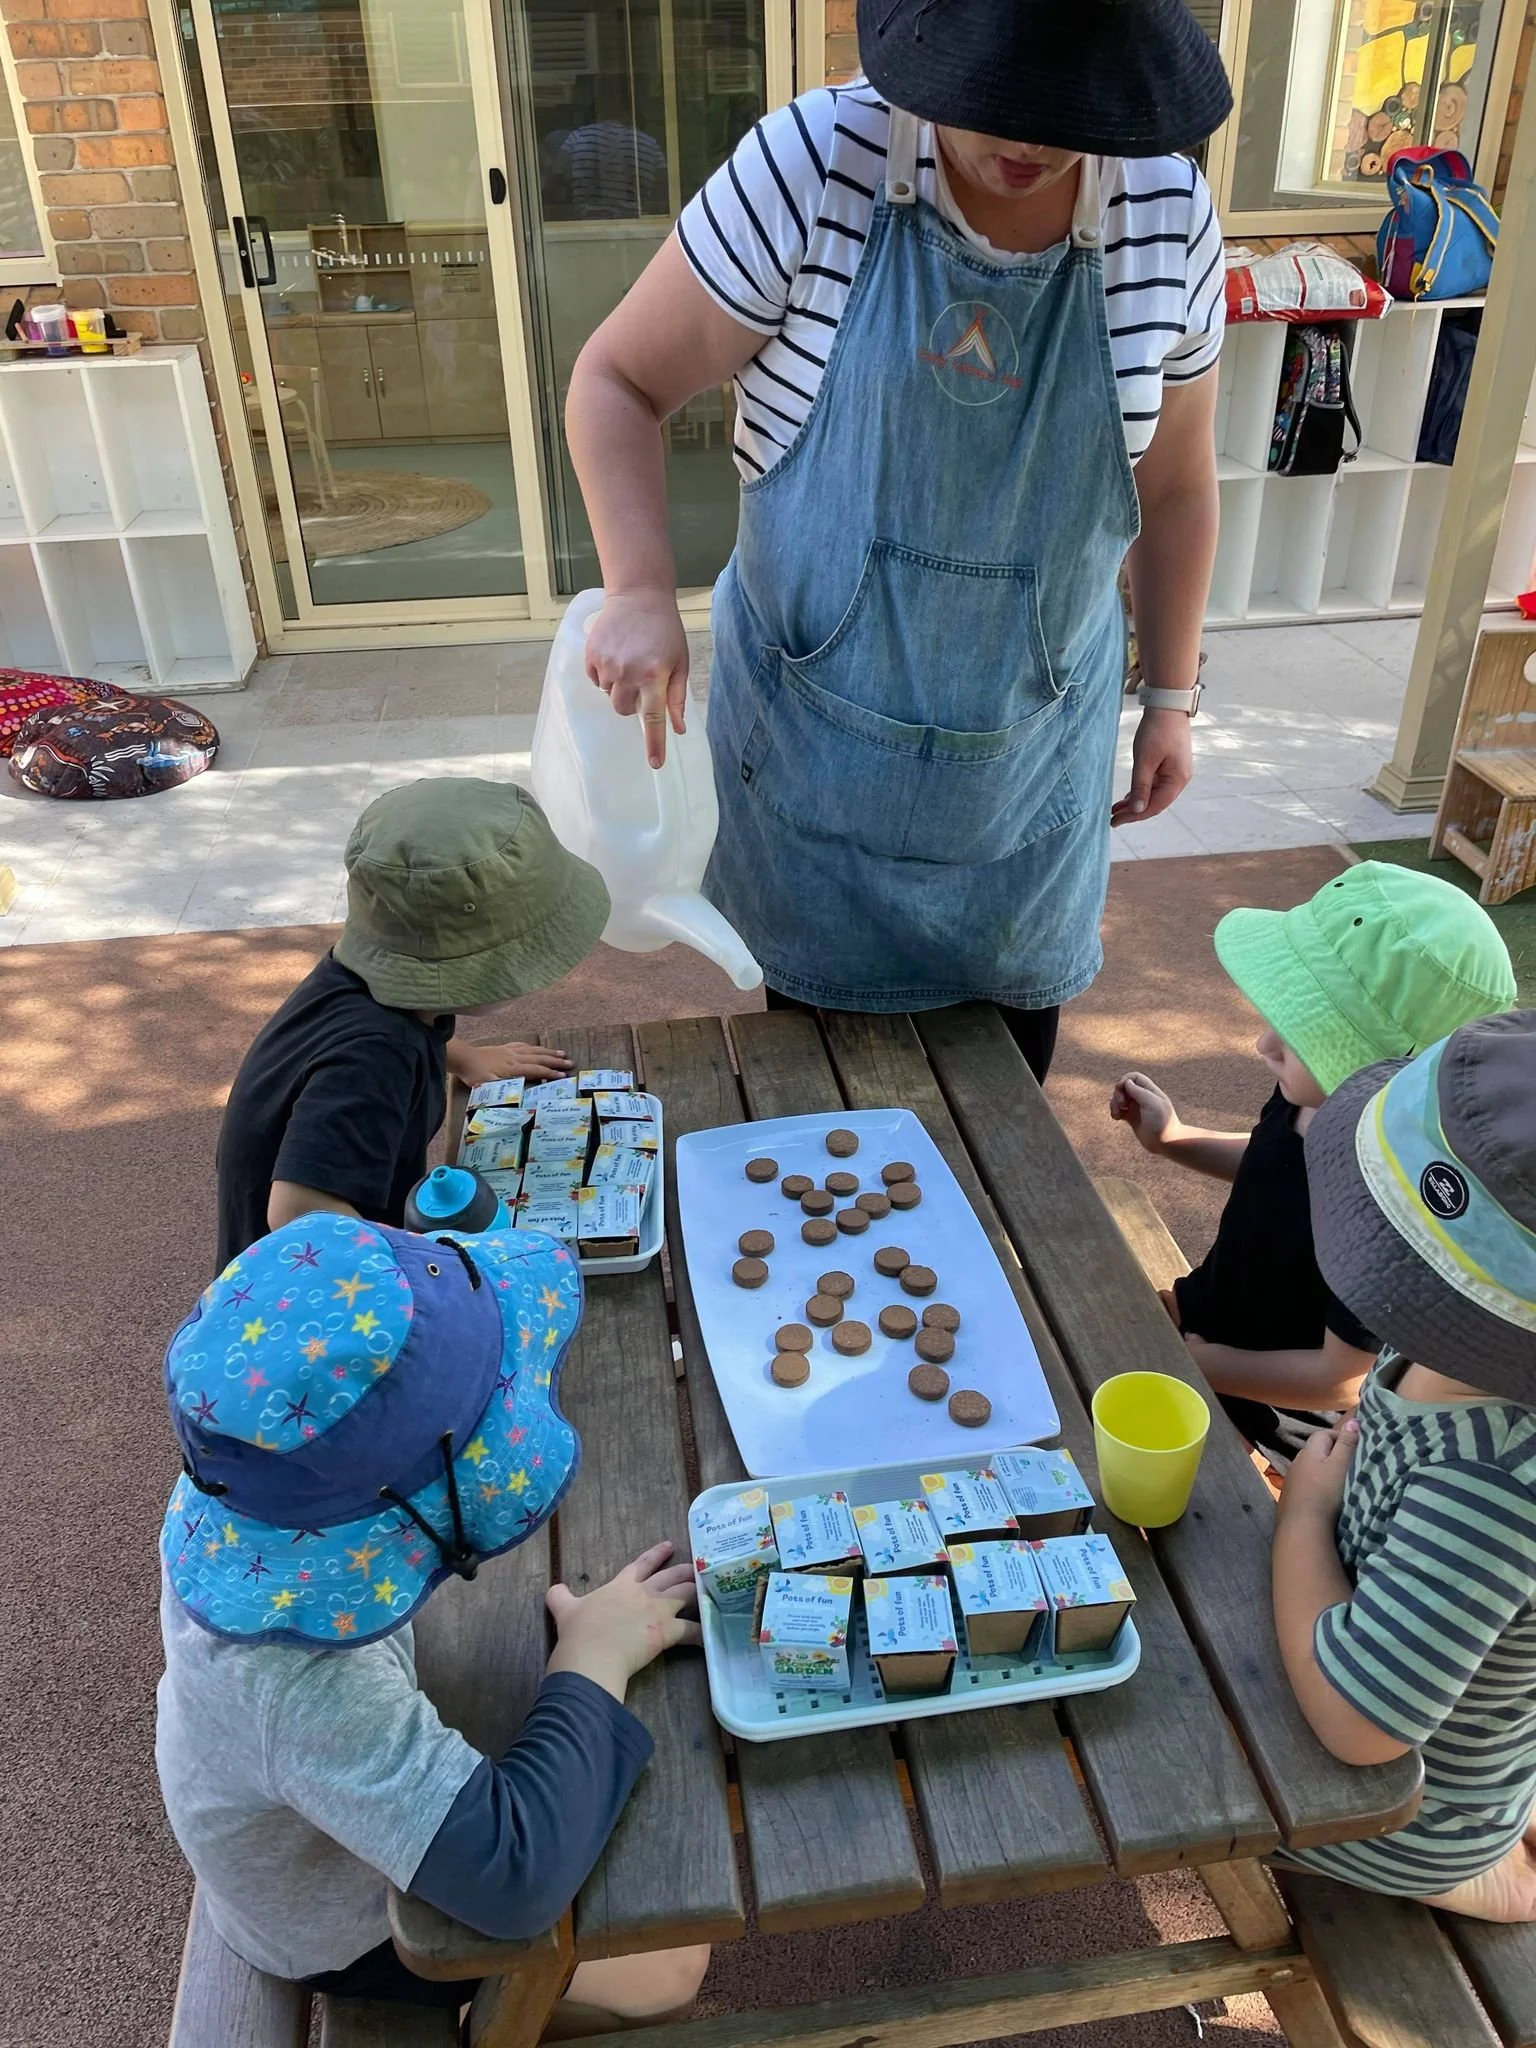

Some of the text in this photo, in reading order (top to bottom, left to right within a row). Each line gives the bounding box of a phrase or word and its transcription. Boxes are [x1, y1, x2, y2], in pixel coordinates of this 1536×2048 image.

[952, 1482, 961, 1494] fun
[960, 1501, 972, 1518] Pots
[706, 1514, 753, 1534] Pots of fun
[800, 1510, 814, 1550] Pots of fun
[884, 1514, 901, 1553] Pots of fun
[982, 1555, 998, 1598] Pots of fun
[1080, 1548, 1101, 1589] Pots of fun
[782, 1594, 802, 1603] Pots
[818, 1597, 833, 1605] fun
[896, 1605, 904, 1614] of
[898, 1615, 906, 1636] Pots
[775, 1667, 833, 1675] GARDEN
